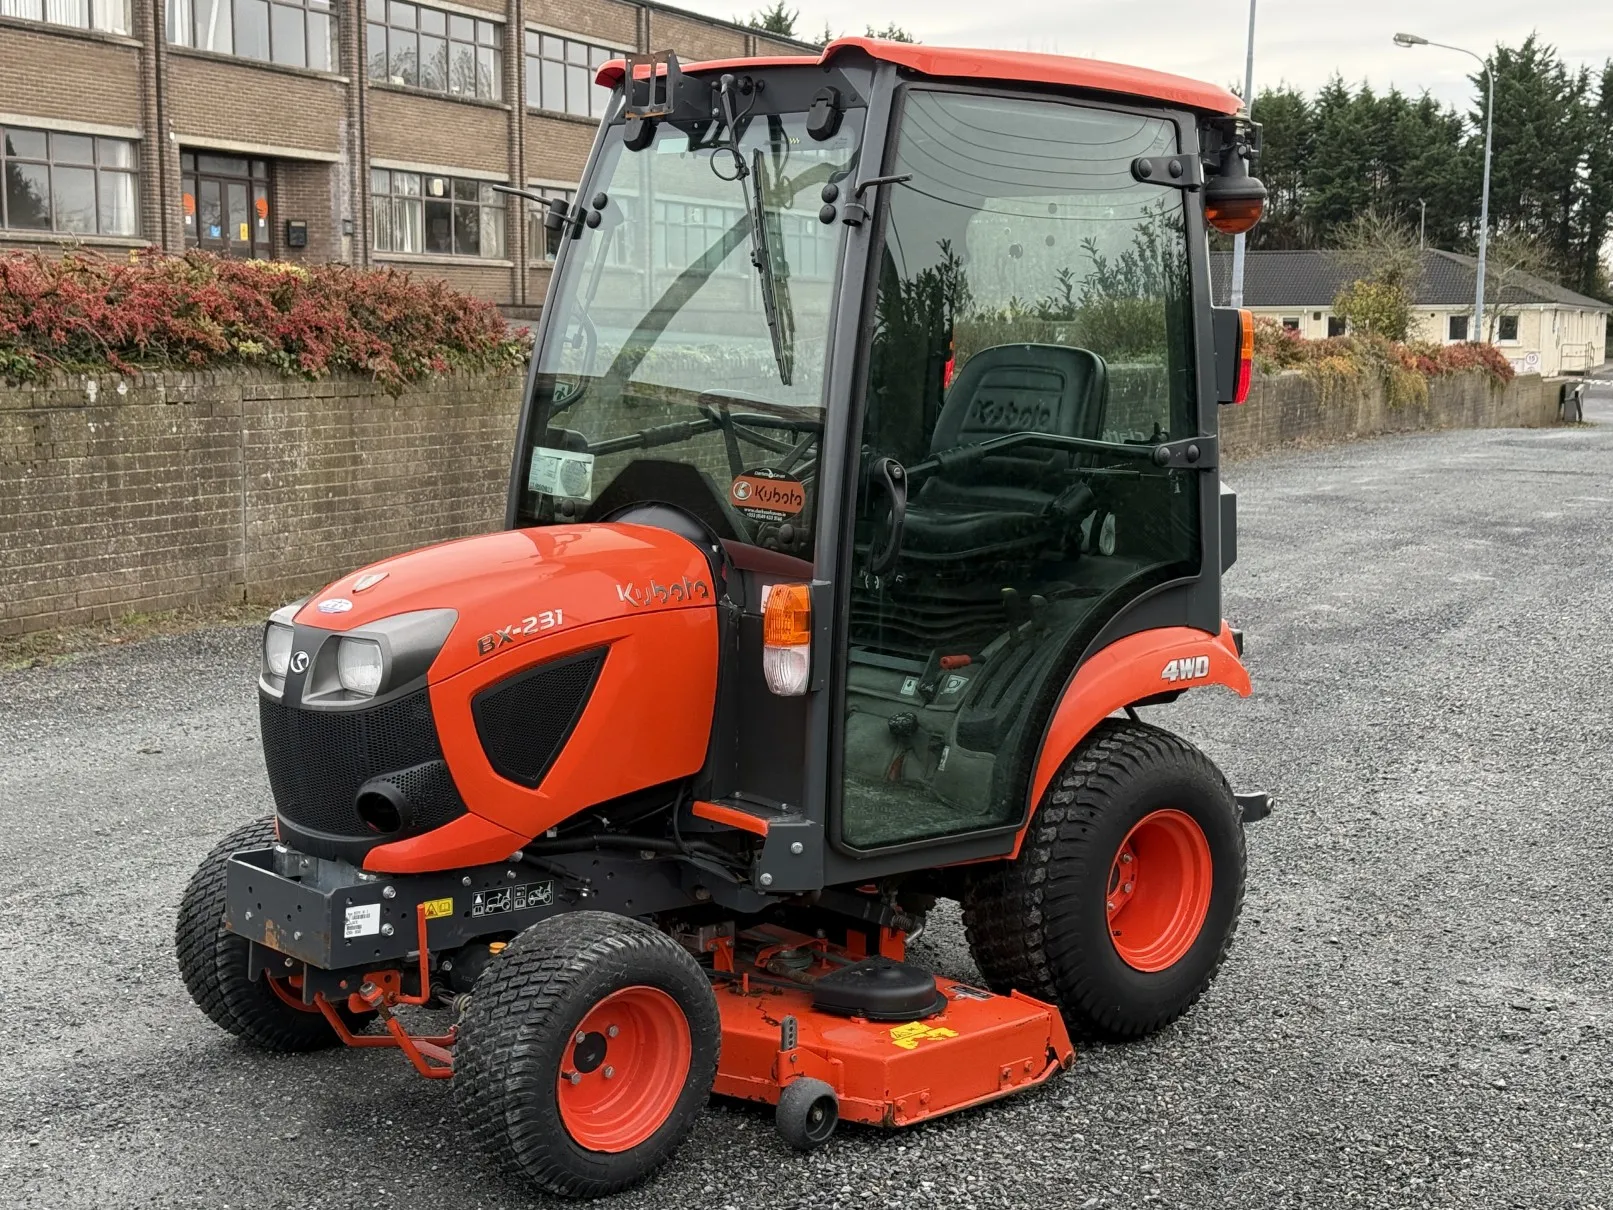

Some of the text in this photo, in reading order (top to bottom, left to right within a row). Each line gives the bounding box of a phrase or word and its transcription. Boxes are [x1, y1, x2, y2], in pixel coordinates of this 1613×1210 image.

[755, 485, 802, 506] Kubota
[615, 576, 709, 607] Kubota
[477, 609, 563, 656] BX-231
[1161, 655, 1210, 684] 4WD
